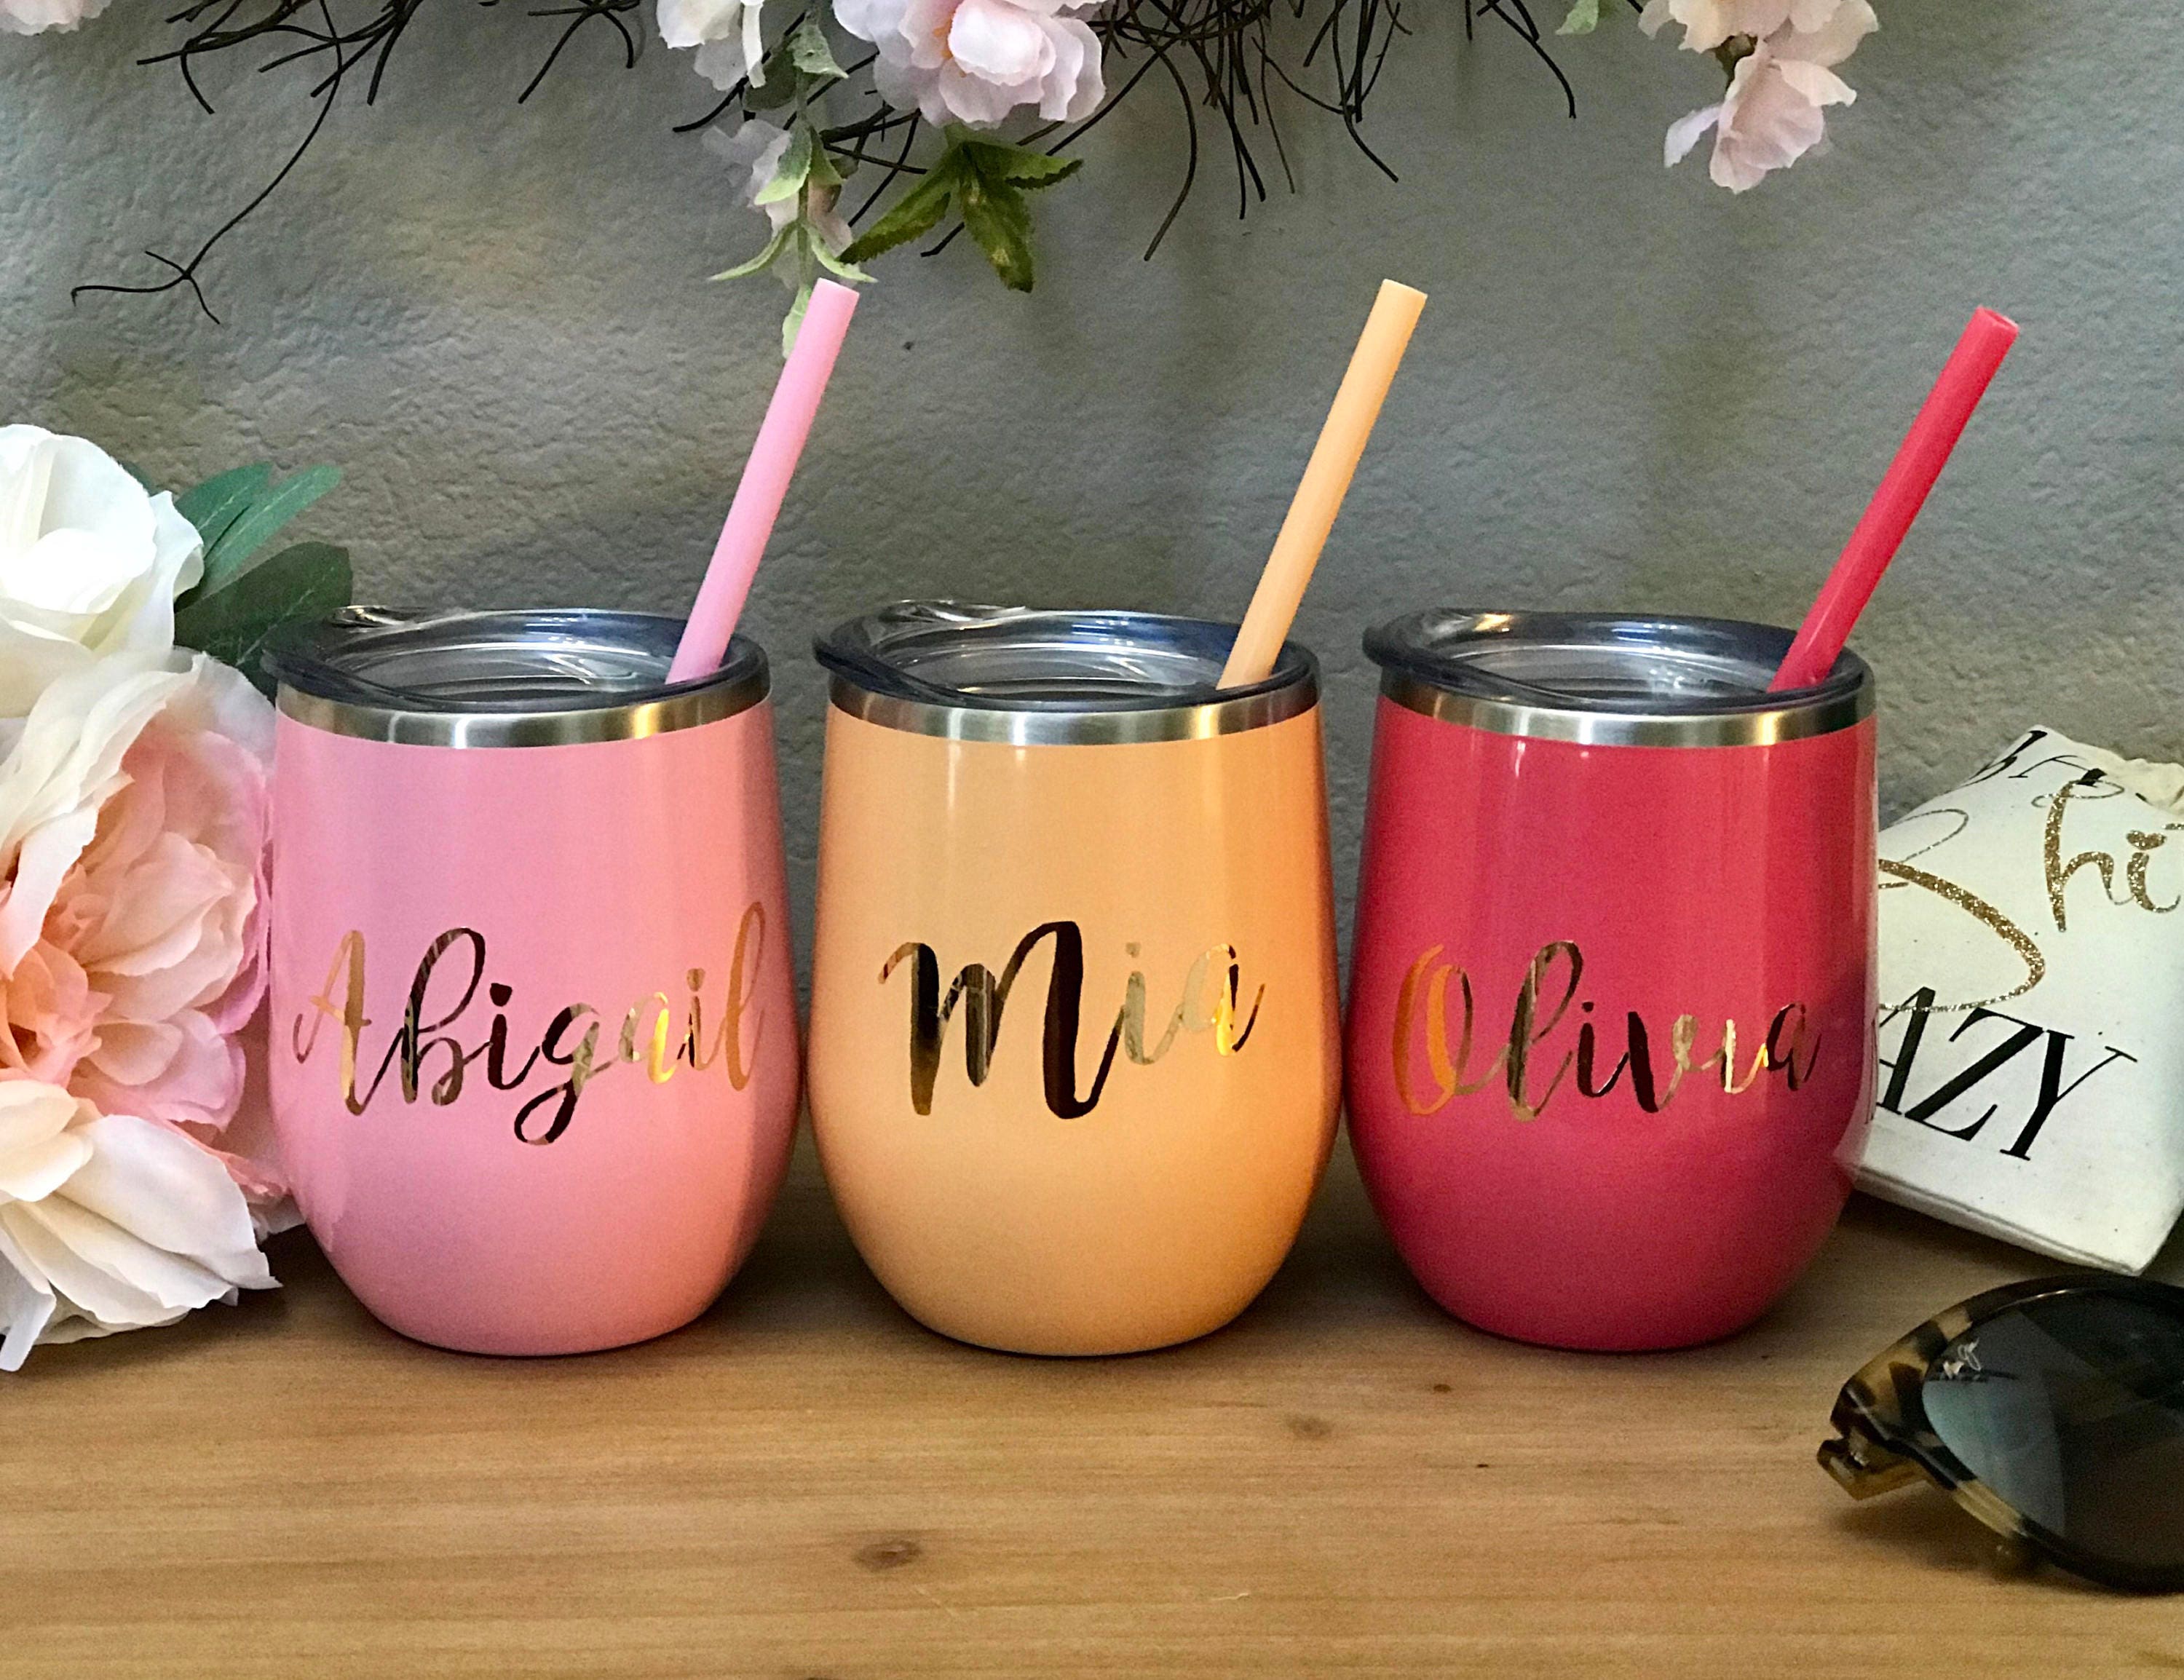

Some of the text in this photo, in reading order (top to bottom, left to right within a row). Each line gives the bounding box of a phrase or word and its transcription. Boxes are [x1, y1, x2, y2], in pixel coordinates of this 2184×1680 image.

[292, 902, 766, 1146] Abigail
[877, 921, 1266, 1120] Mia
[1392, 940, 1821, 1122] Olivia
